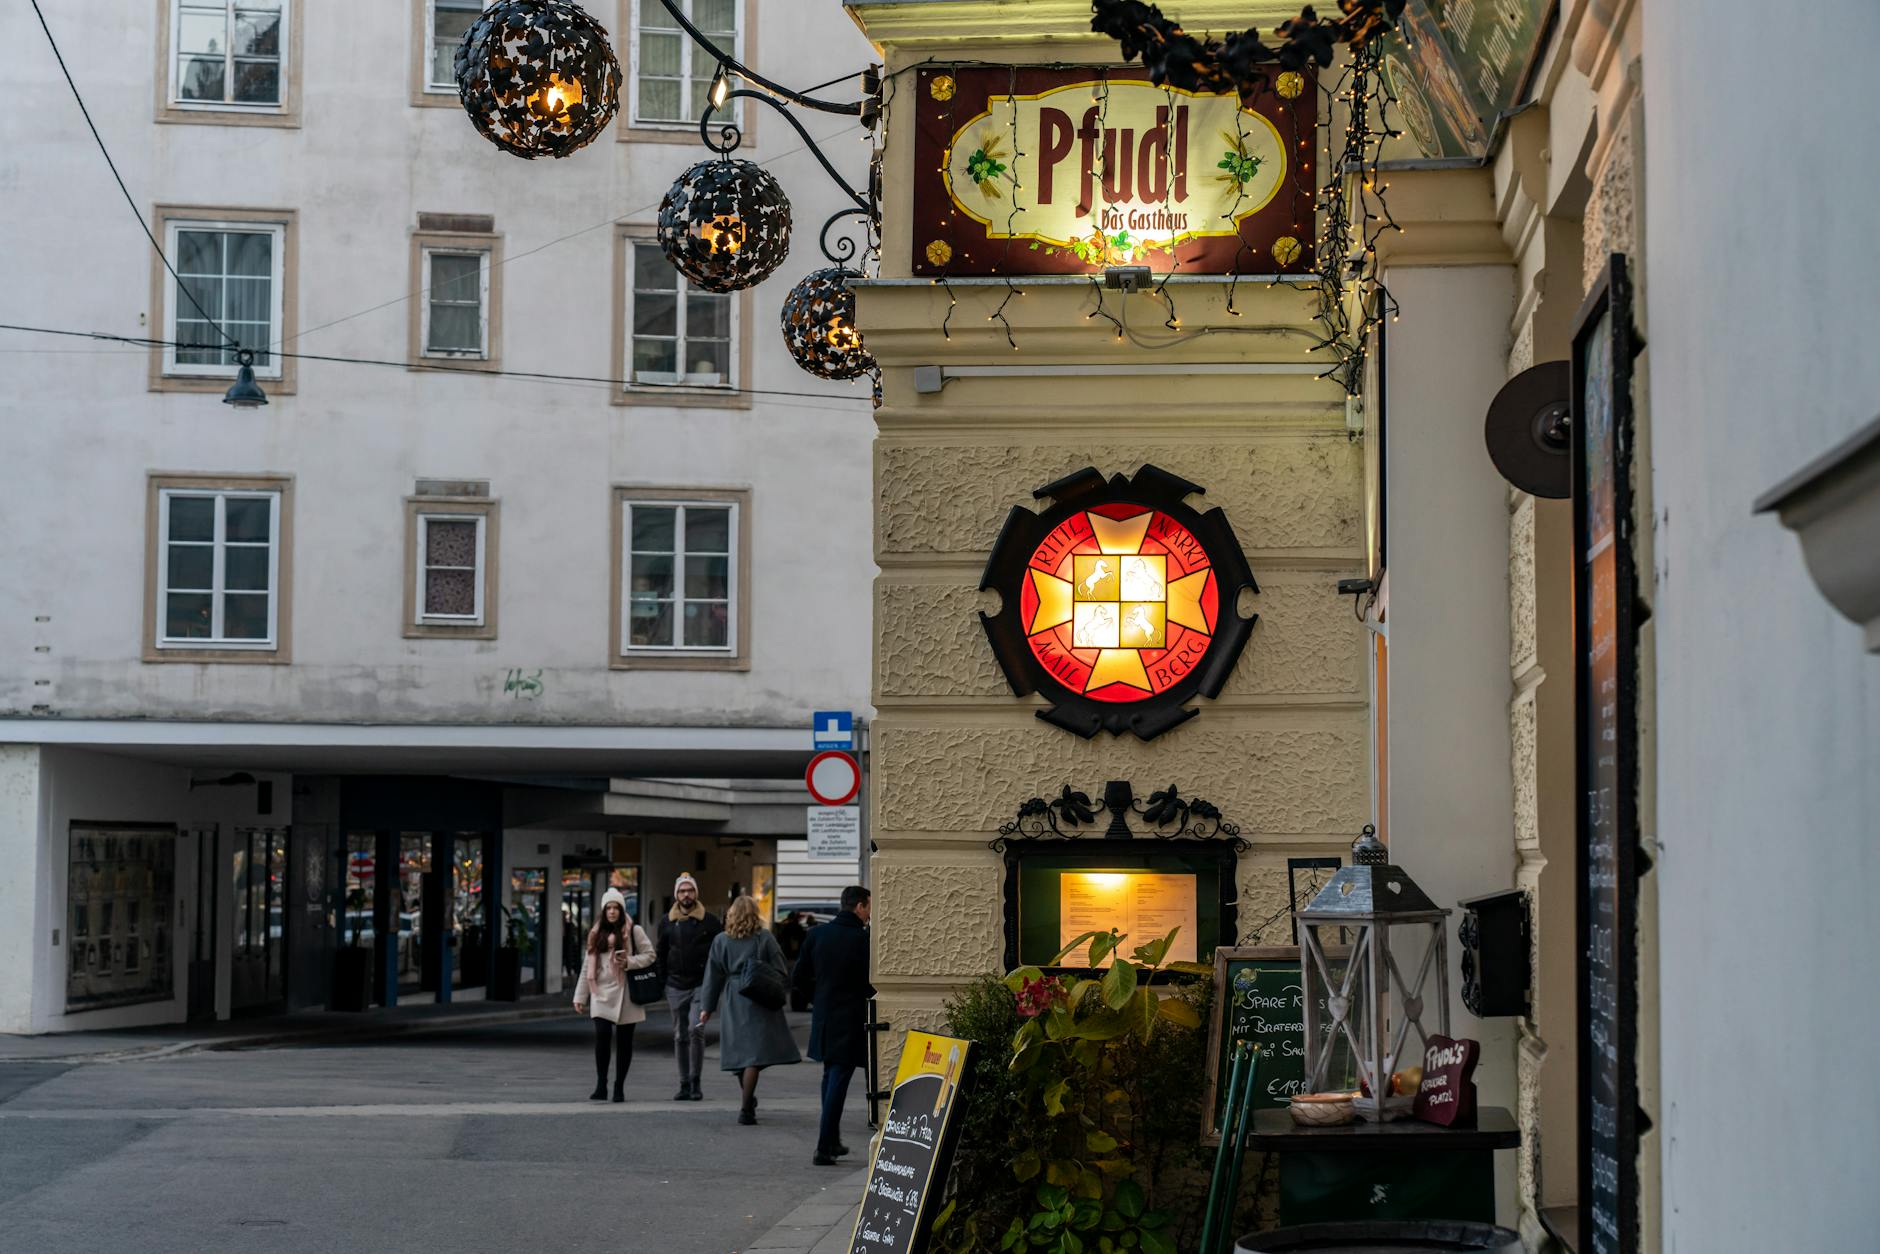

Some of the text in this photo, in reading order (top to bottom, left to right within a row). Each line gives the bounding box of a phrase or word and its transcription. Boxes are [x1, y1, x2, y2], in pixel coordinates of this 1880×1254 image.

[1037, 105, 1190, 218] Pfudl
[1101, 209, 1188, 231] Das Gasthaus
[1151, 517, 1208, 567] MARKT
[1032, 638, 1081, 686] MAIL
[1155, 637, 1207, 688] BERG
[1241, 989, 1286, 1010] SPARE
